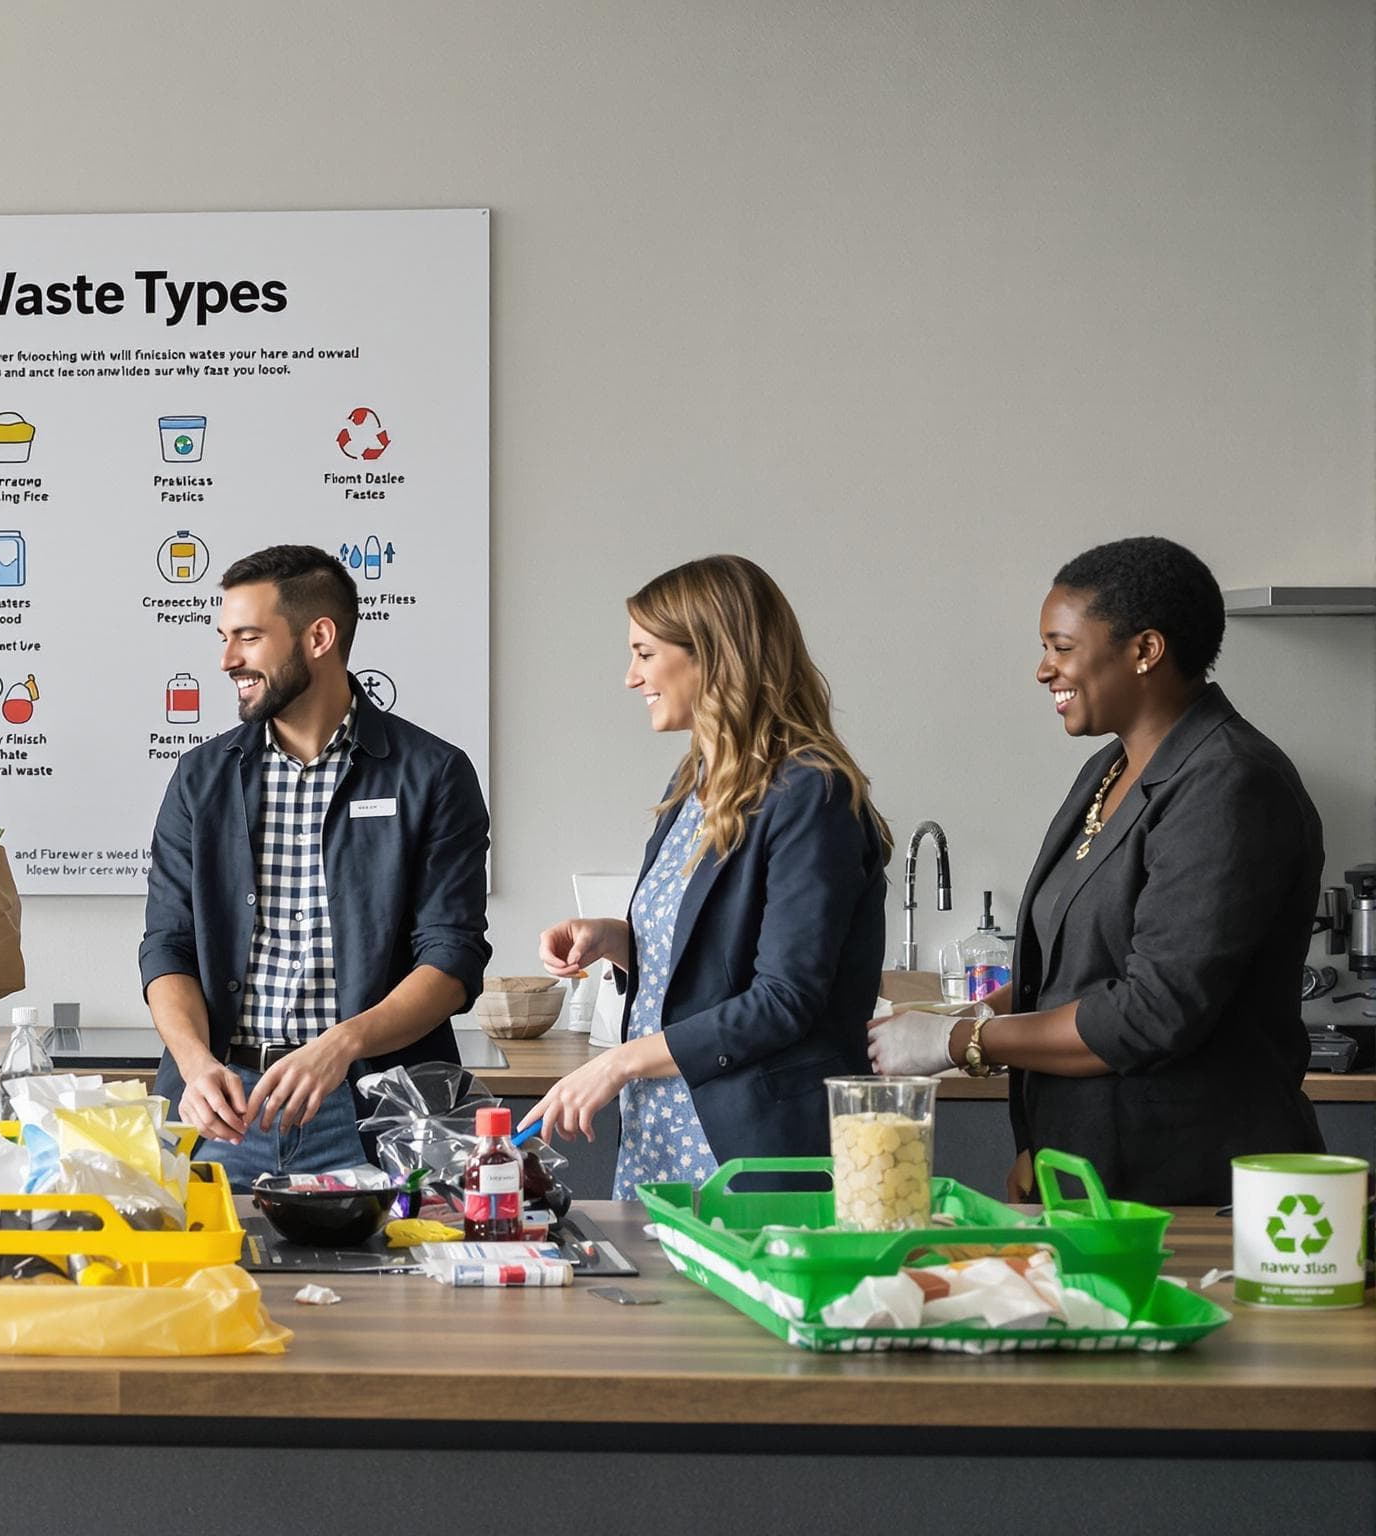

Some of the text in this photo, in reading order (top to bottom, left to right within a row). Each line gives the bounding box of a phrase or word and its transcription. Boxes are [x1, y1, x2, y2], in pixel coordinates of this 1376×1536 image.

[134, 270, 288, 327] Types
[228, 350, 257, 362] your
[291, 347, 315, 360] and
[4, 367, 26, 378] and
[232, 366, 255, 378] you
[14, 765, 55, 778] waste
[14, 848, 37, 860] and
